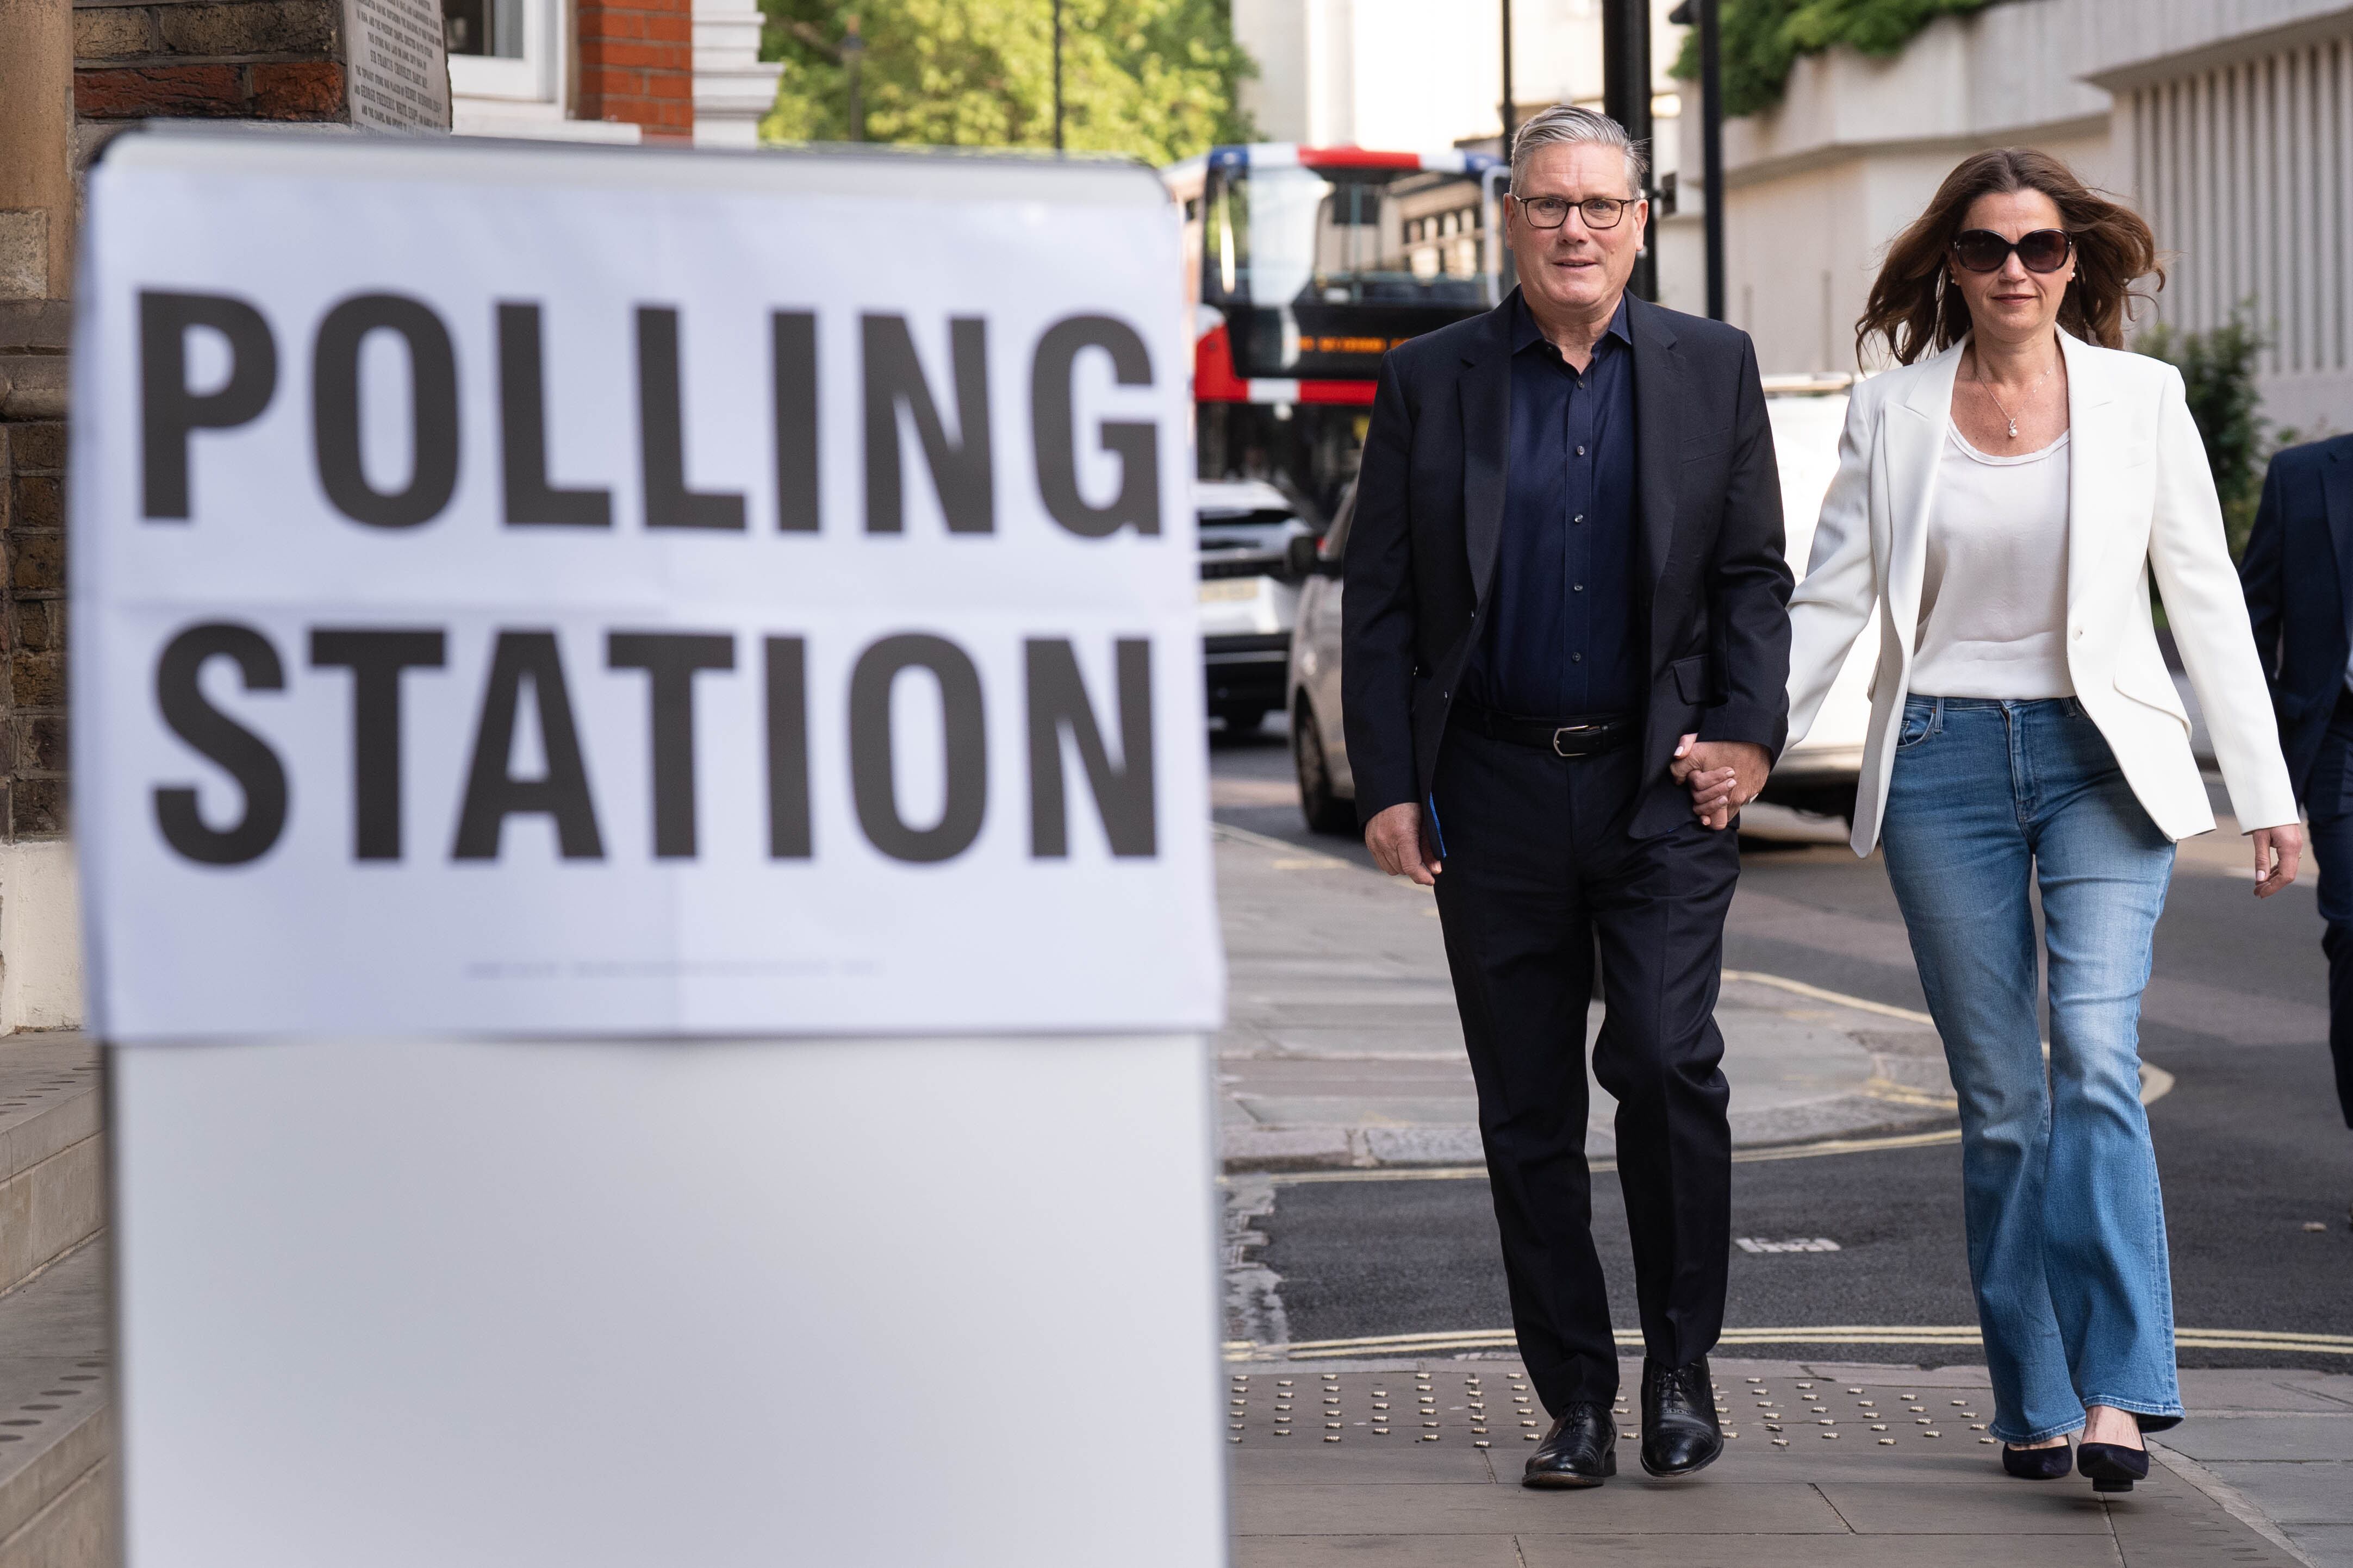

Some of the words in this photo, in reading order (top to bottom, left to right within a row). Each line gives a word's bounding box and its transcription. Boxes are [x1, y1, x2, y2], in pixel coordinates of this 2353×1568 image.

[360, 84, 375, 102] GEORGE
[138, 288, 1160, 538] POLLING
[152, 619, 1158, 870] STATION
